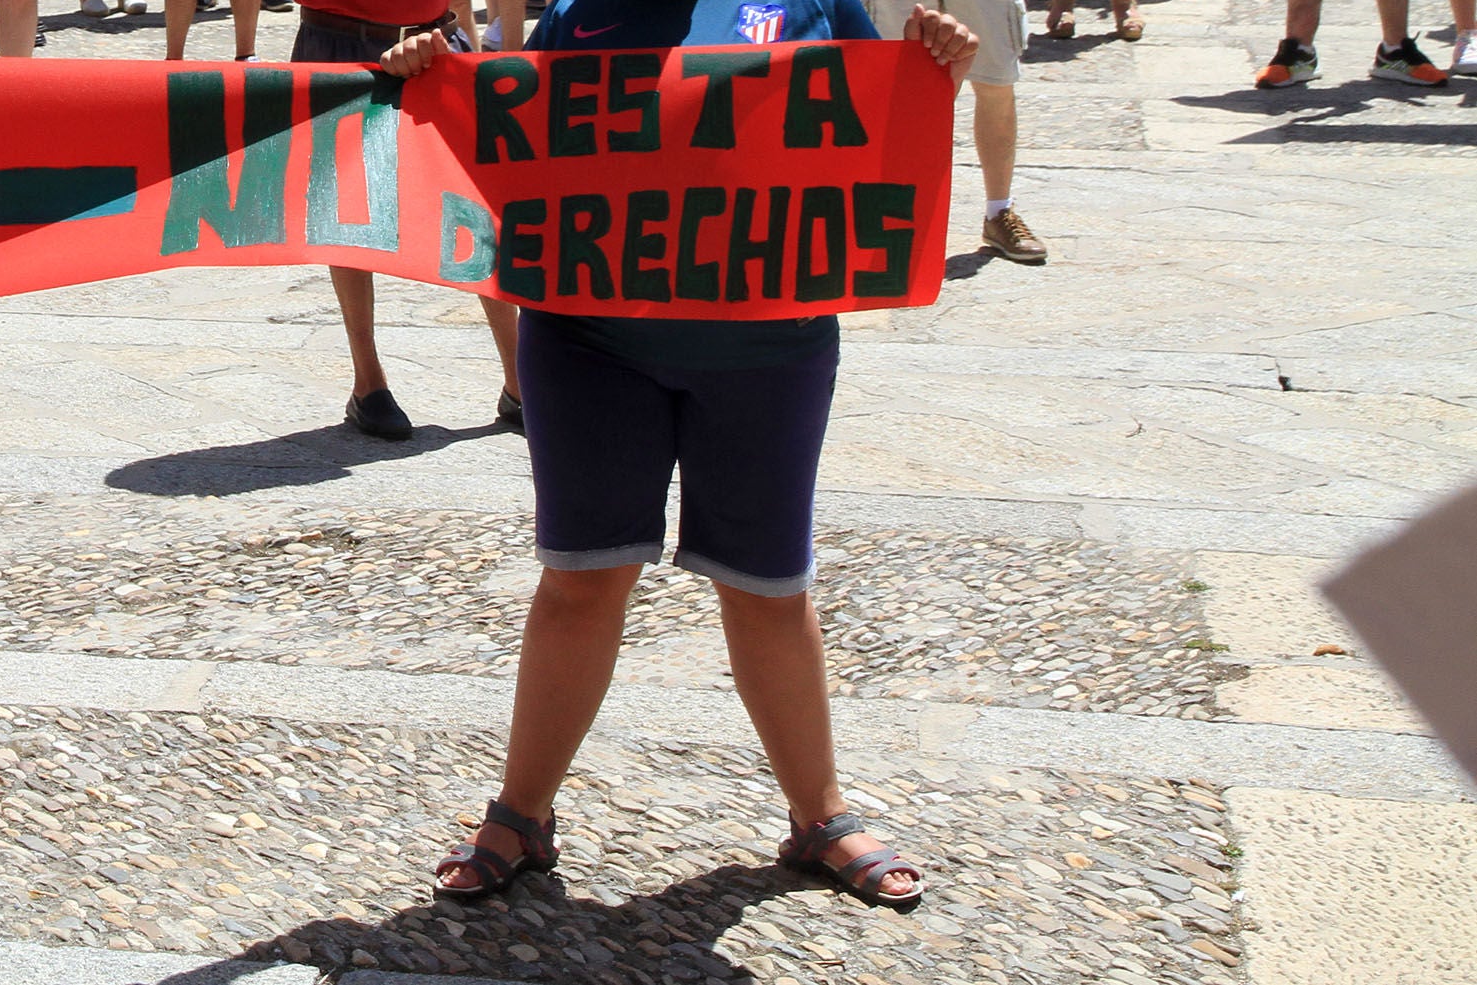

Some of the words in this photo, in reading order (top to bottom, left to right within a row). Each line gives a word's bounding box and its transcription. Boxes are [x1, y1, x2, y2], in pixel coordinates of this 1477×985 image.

[160, 69, 402, 257] NO
[472, 46, 868, 165] RESTA
[438, 182, 916, 303] DERECHOS
